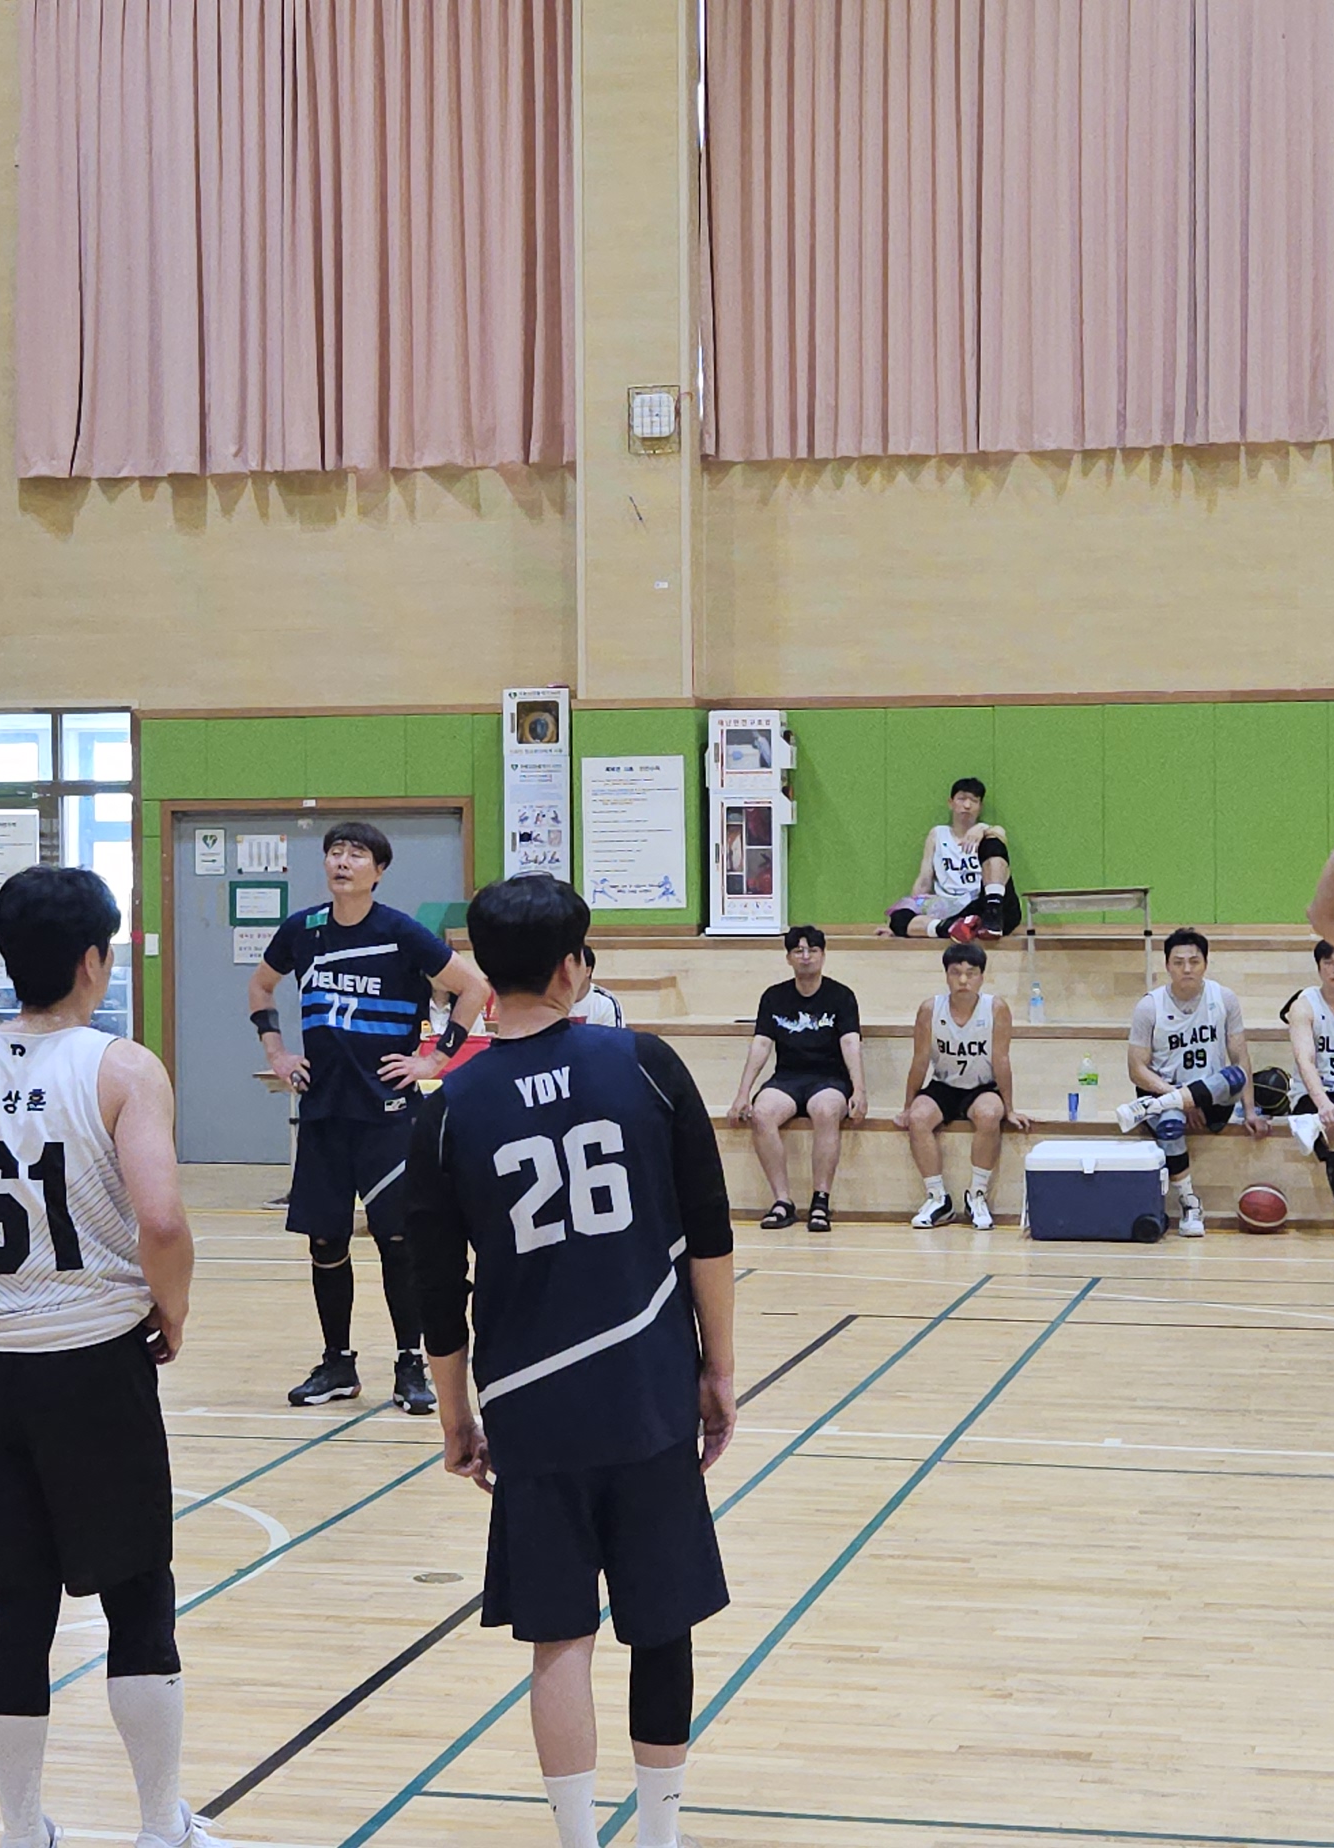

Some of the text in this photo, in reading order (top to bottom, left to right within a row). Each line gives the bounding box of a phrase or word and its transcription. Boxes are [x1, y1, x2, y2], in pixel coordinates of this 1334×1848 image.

[325, 993, 358, 1031] 77
[936, 1038, 988, 1057] BLACK
[1168, 1025, 1218, 1051] BLACK
[956, 1060, 968, 1076] 7
[1183, 1048, 1207, 1070] 89
[514, 1066, 570, 1108] YDY
[493, 1119, 633, 1254] 26
